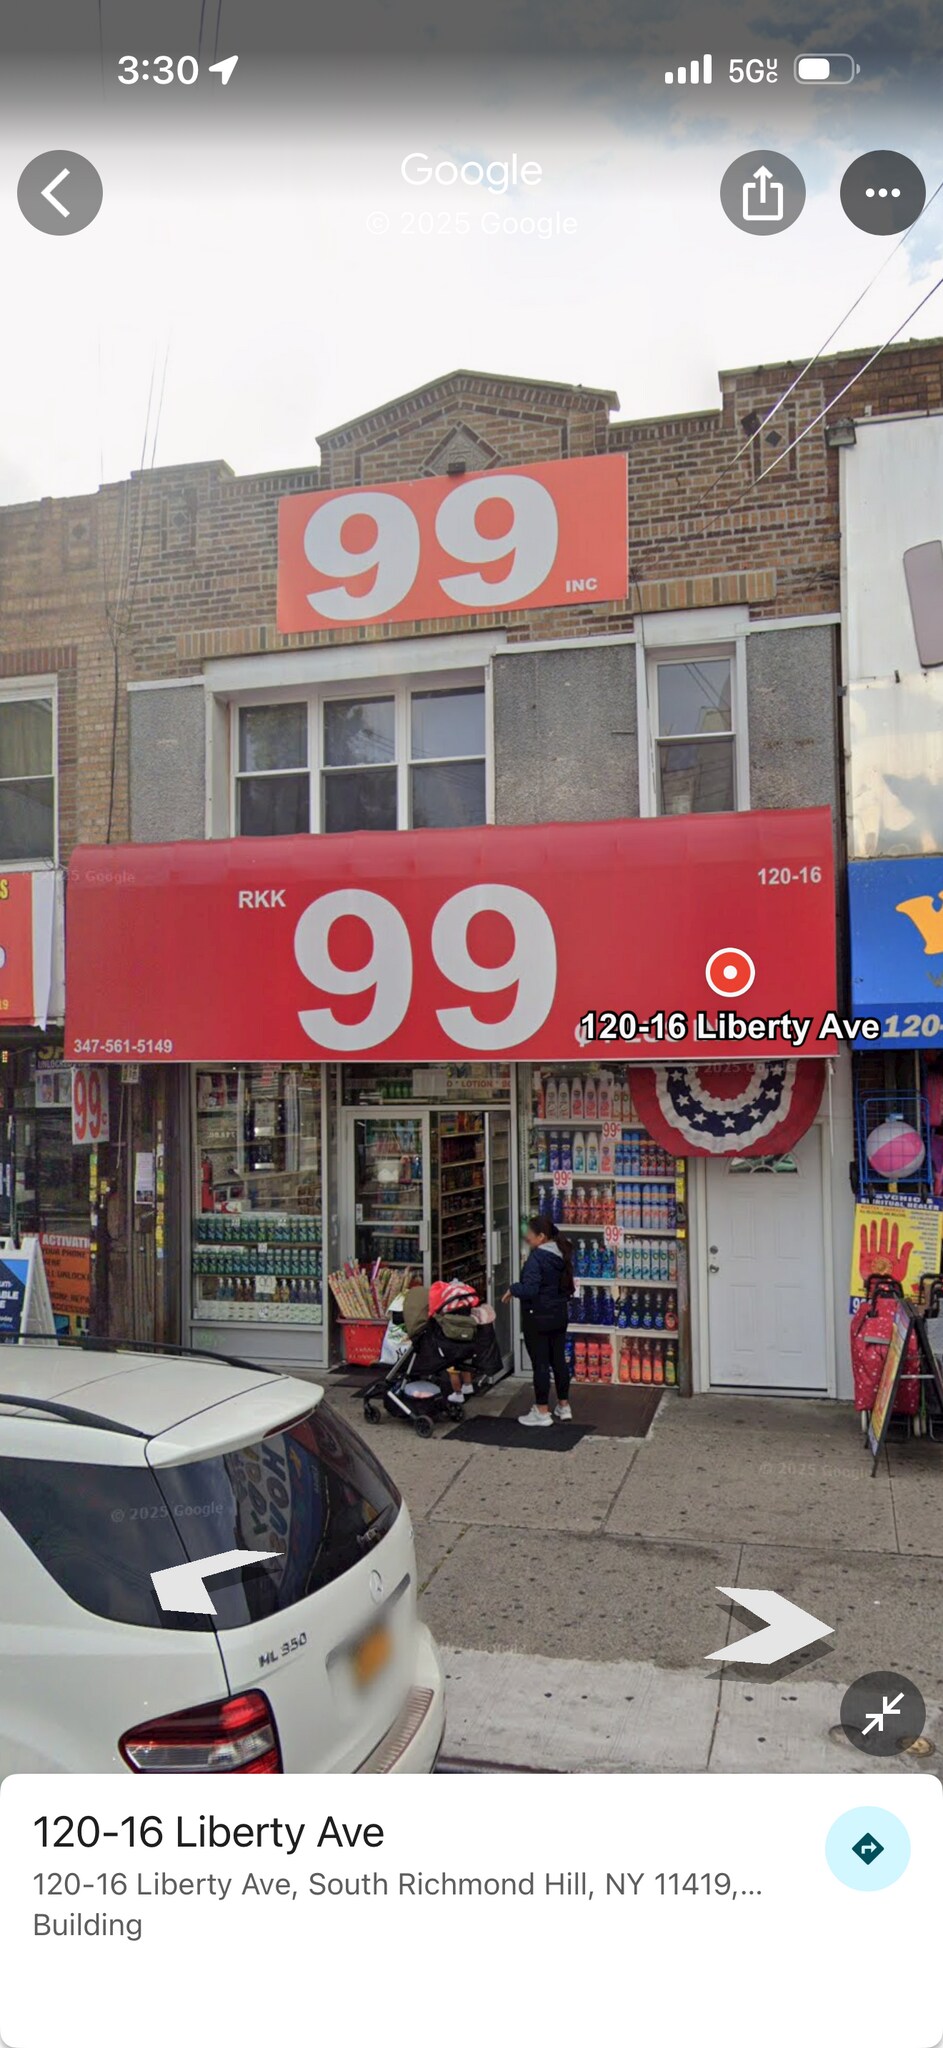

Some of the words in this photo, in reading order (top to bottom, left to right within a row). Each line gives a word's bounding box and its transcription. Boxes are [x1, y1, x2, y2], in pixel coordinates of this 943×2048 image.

[303, 473, 559, 622] 99
[565, 577, 598, 594] INC
[757, 866, 822, 885] 120-16
[238, 889, 287, 909] RKK
[293, 883, 558, 1052] 99
[74, 1039, 173, 1053] 347-561-5149
[281, 1631, 308, 1657] 350
